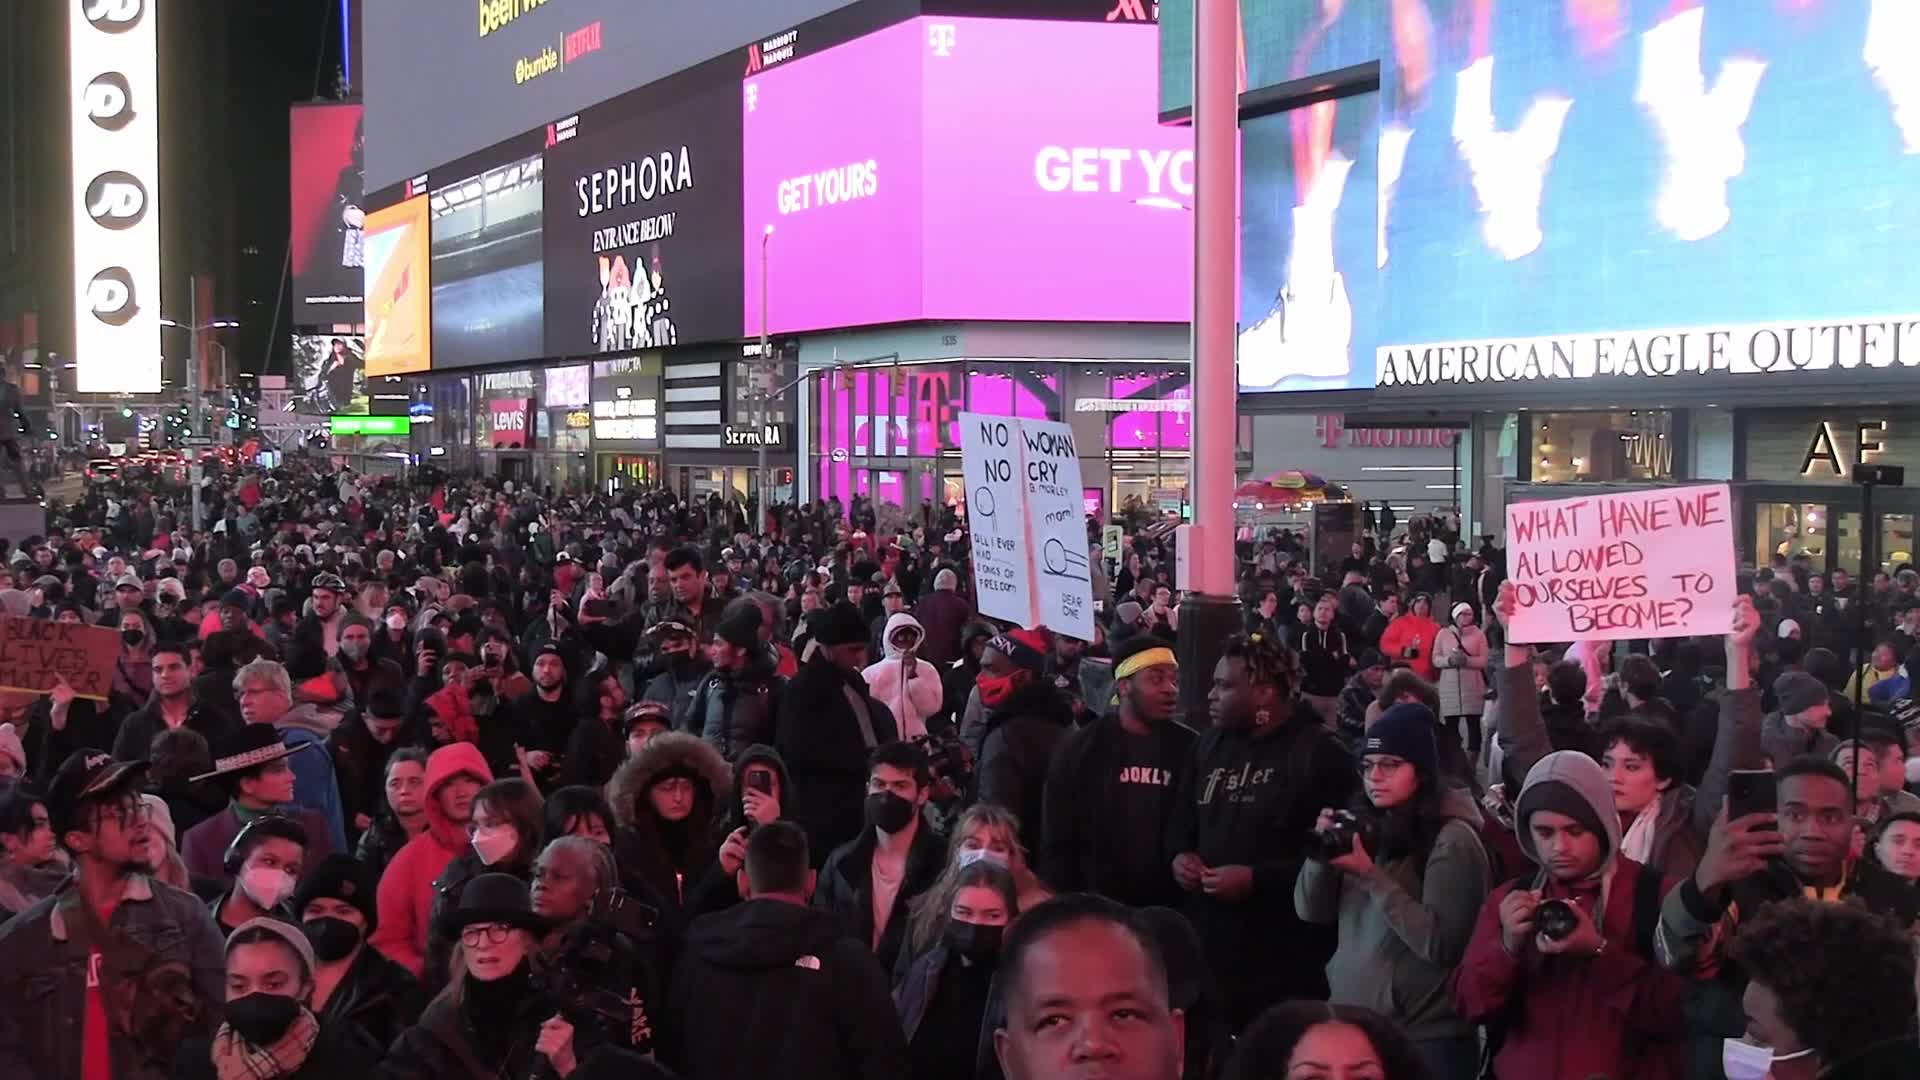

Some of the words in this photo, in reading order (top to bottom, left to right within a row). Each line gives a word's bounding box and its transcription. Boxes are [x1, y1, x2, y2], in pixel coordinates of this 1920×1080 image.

[565, 21, 601, 64] NETFLIX
[577, 145, 693, 217] SEPHORA
[777, 175, 812, 215] GET
[813, 159, 878, 207] YOURS
[1035, 145, 1132, 192] GET
[1136, 149, 1193, 195] YO
[592, 221, 641, 253] ENTRANCE
[640, 212, 676, 243] BELOW
[1379, 339, 1577, 386] AMERICAN
[1592, 331, 1731, 377] EAGLE
[980, 421, 1009, 448] NO
[1022, 429, 1076, 459] WOMAN
[984, 458, 1011, 483] NO
[1028, 460, 1058, 485] CRY
[1511, 501, 1589, 545] WHAT
[1598, 498, 1672, 538] HAVE
[1675, 491, 1725, 528] WE
[1516, 540, 1644, 580] ALLOWED
[1514, 575, 1648, 608] OURSELVES
[1671, 573, 1714, 594] TO
[1567, 598, 1694, 633] BECOME?
